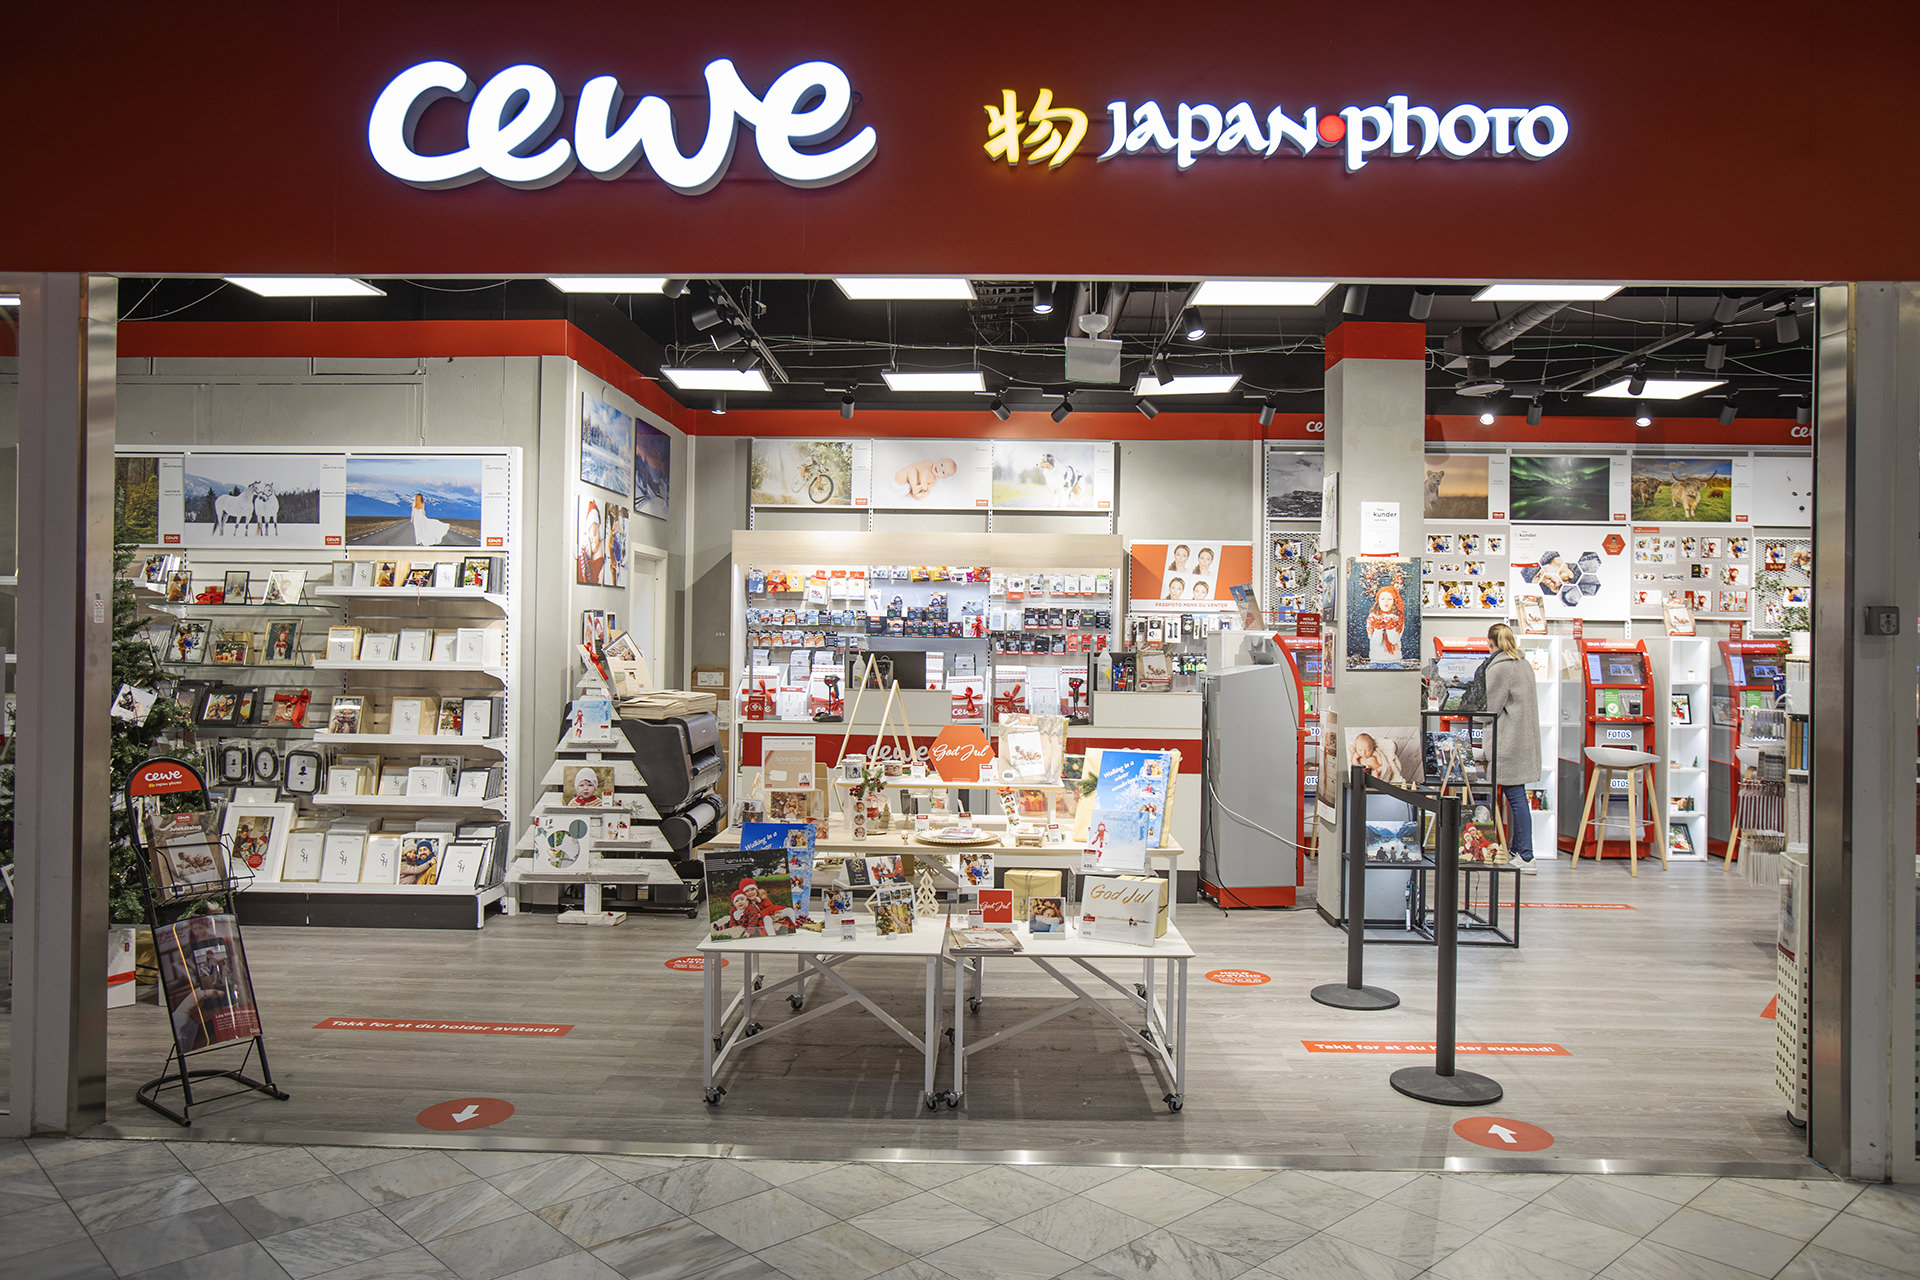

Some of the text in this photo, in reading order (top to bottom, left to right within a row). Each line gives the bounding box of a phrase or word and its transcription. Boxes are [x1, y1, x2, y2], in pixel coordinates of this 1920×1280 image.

[368, 58, 878, 193] cewe
[1607, 730, 1631, 738] FOTOS
[932, 743, 990, 761] God Jul
[144, 770, 183, 782] cewe
[1103, 765, 1124, 779] Walking
[1612, 780, 1629, 788] OTOS
[1090, 884, 1154, 904] God Jul
[980, 902, 1011, 911] God Jul
